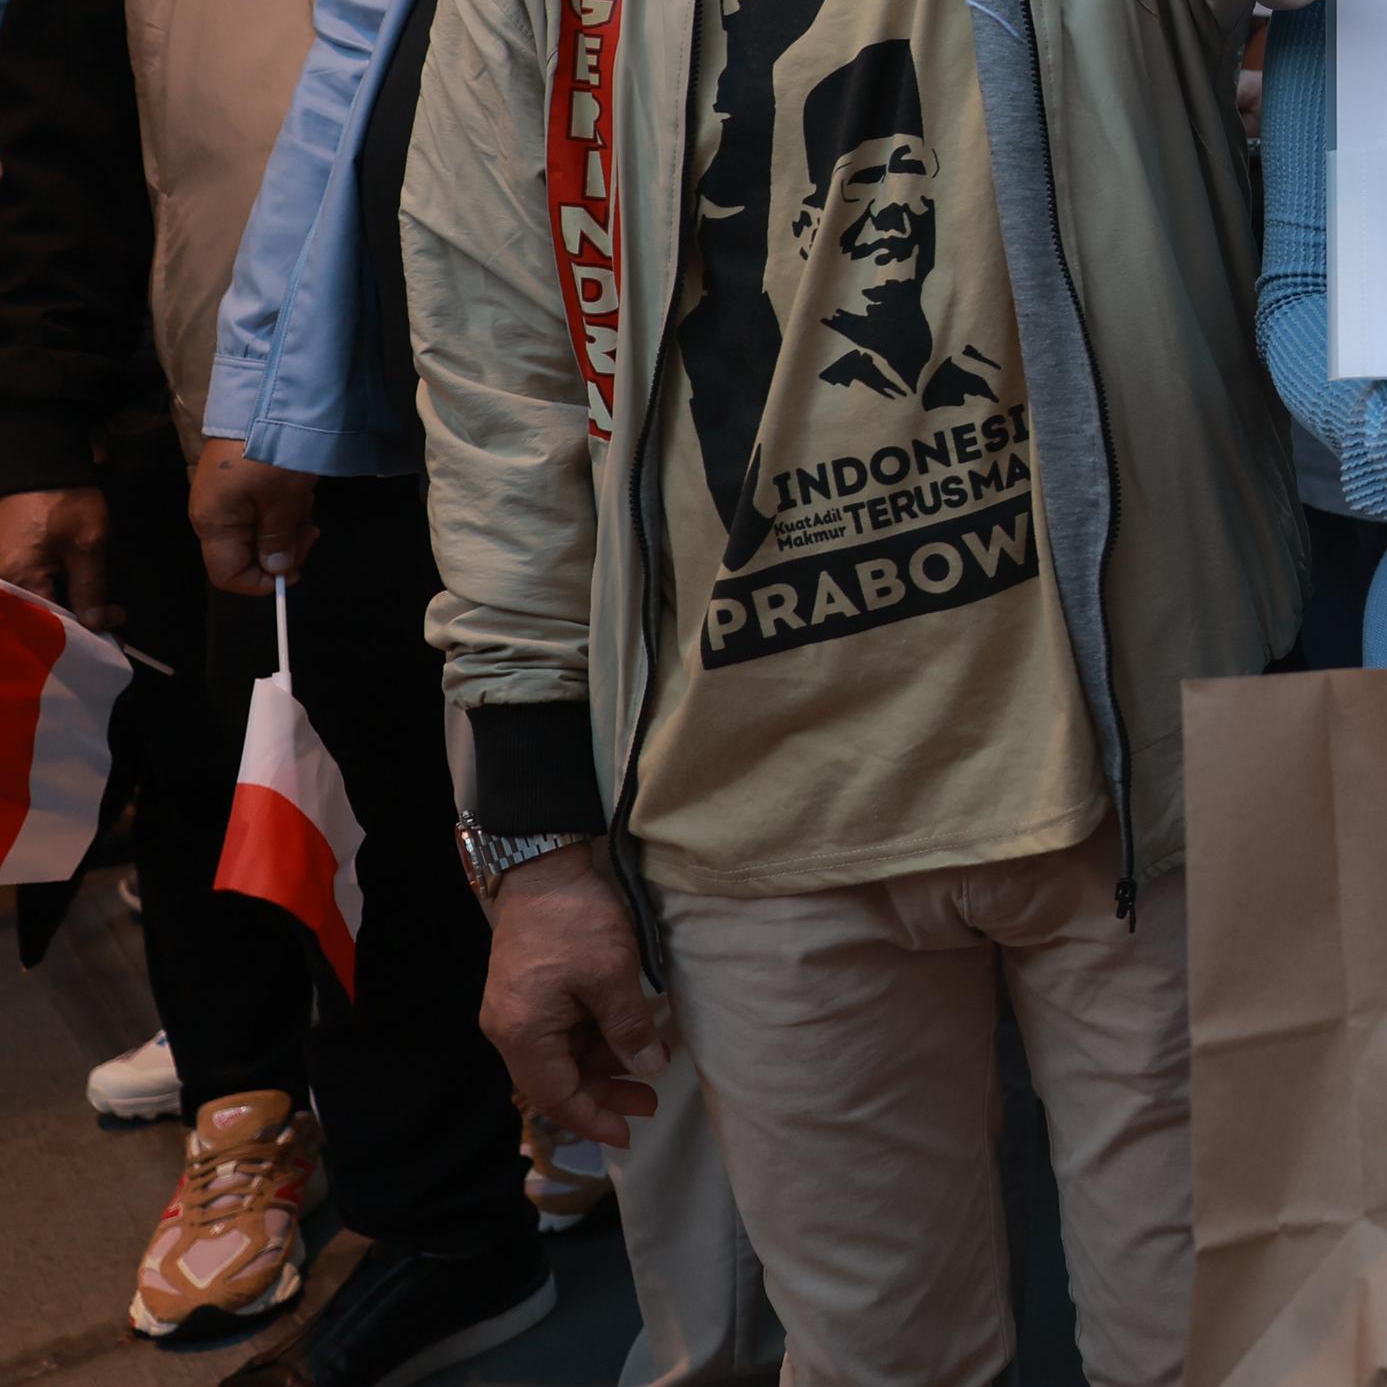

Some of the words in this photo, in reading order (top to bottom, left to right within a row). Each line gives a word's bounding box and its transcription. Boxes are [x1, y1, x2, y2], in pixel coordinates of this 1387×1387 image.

[774, 515, 814, 538] Kuat
[813, 508, 843, 526] Adil
[842, 474, 968, 535] TERUS
[776, 526, 846, 552] Makmur
[707, 511, 1030, 652] PRABOW
